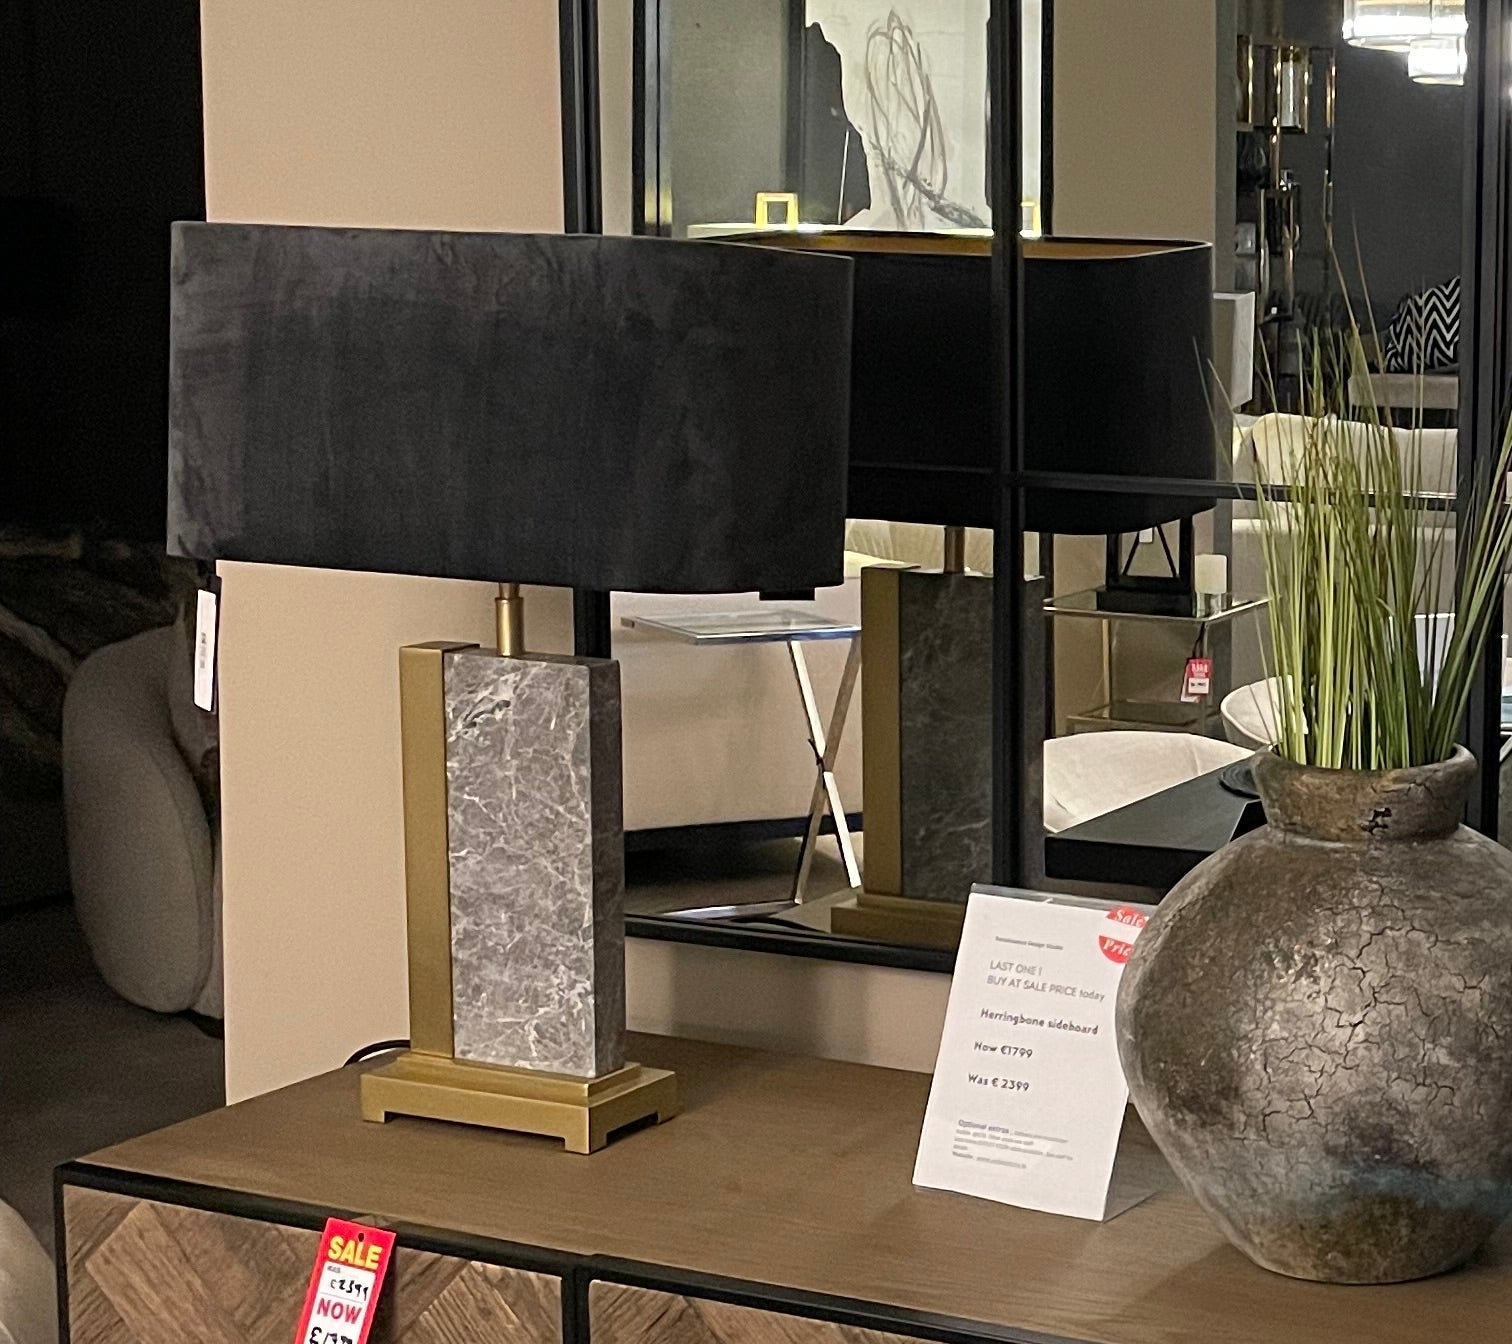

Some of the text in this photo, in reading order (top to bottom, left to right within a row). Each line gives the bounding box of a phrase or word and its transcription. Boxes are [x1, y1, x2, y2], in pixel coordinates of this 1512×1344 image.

[1103, 938, 1133, 957] Pric
[989, 959, 1014, 971] LAST
[1015, 963, 1038, 976] ONE
[986, 975, 1106, 1003] BUY AT SALE PRICE today
[980, 1007, 1099, 1035] Herringbone sideboard
[973, 1041, 1033, 1058] Now €1799
[968, 1072, 989, 1086] Was
[327, 1235, 383, 1271] SALE
[317, 1297, 362, 1325] NOW
